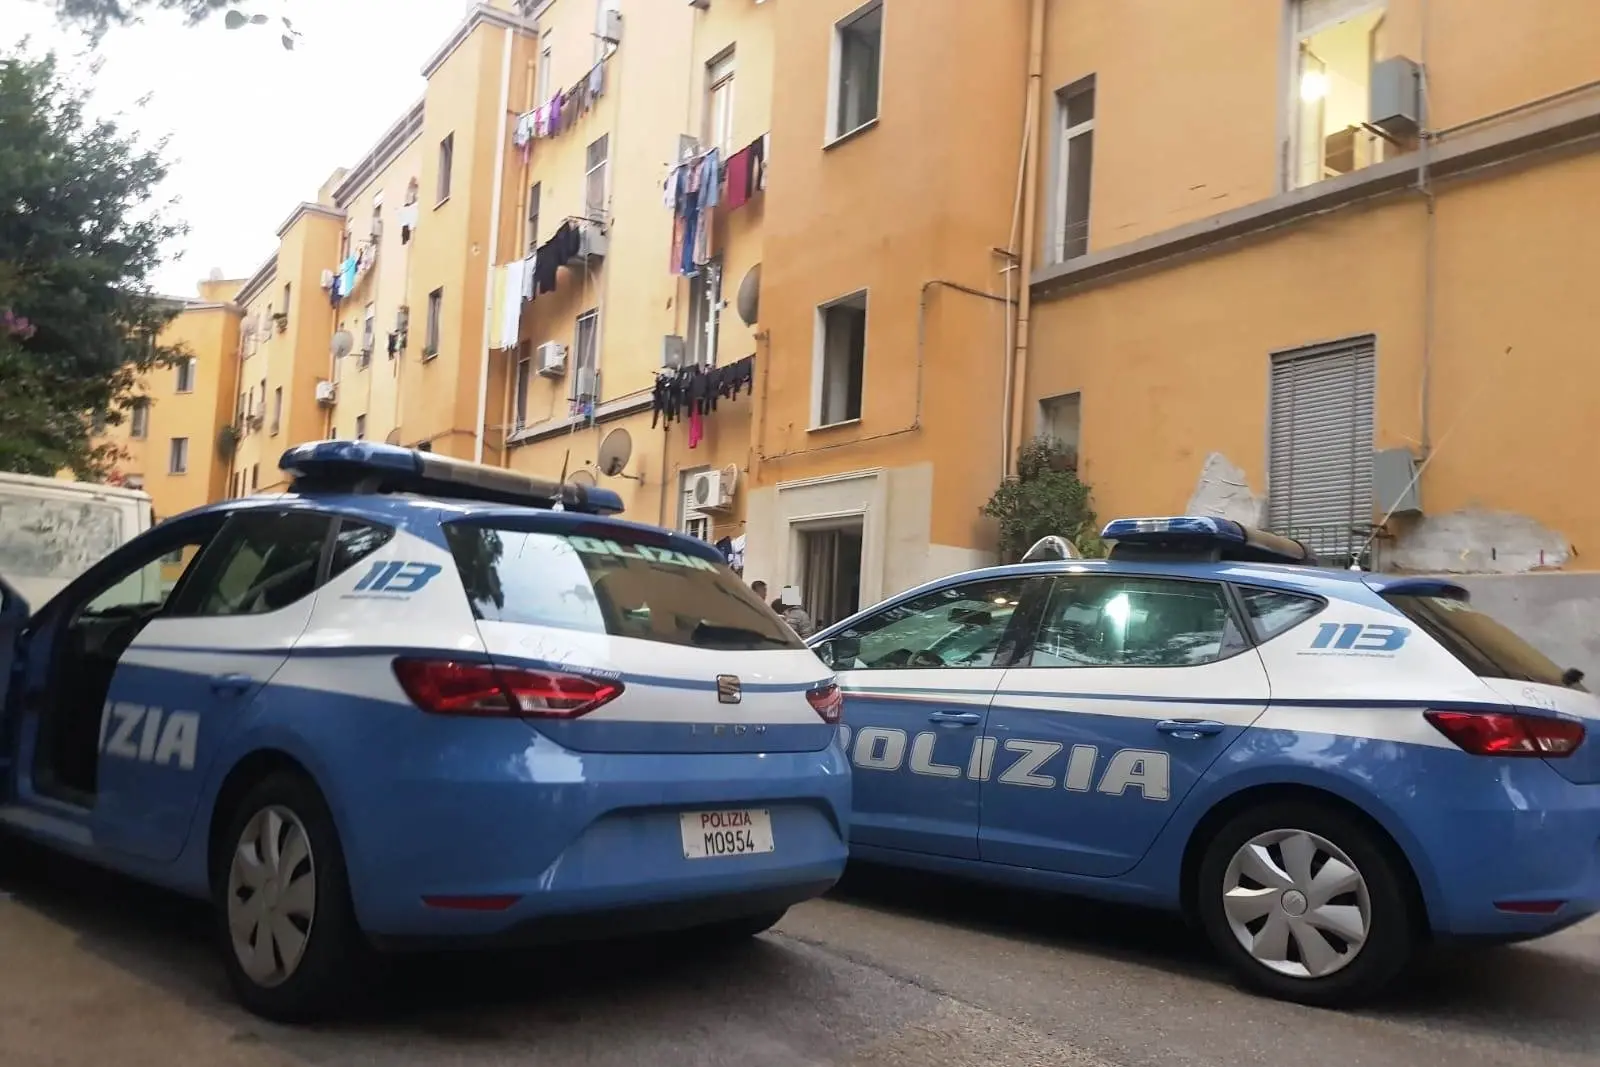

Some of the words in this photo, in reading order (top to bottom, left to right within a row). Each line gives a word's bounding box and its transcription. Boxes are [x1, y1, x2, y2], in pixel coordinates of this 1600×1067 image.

[558, 535, 720, 574] OLIZIA
[353, 561, 442, 592] 113
[1310, 622, 1411, 651] 113
[702, 811, 752, 829] POLIZIA
